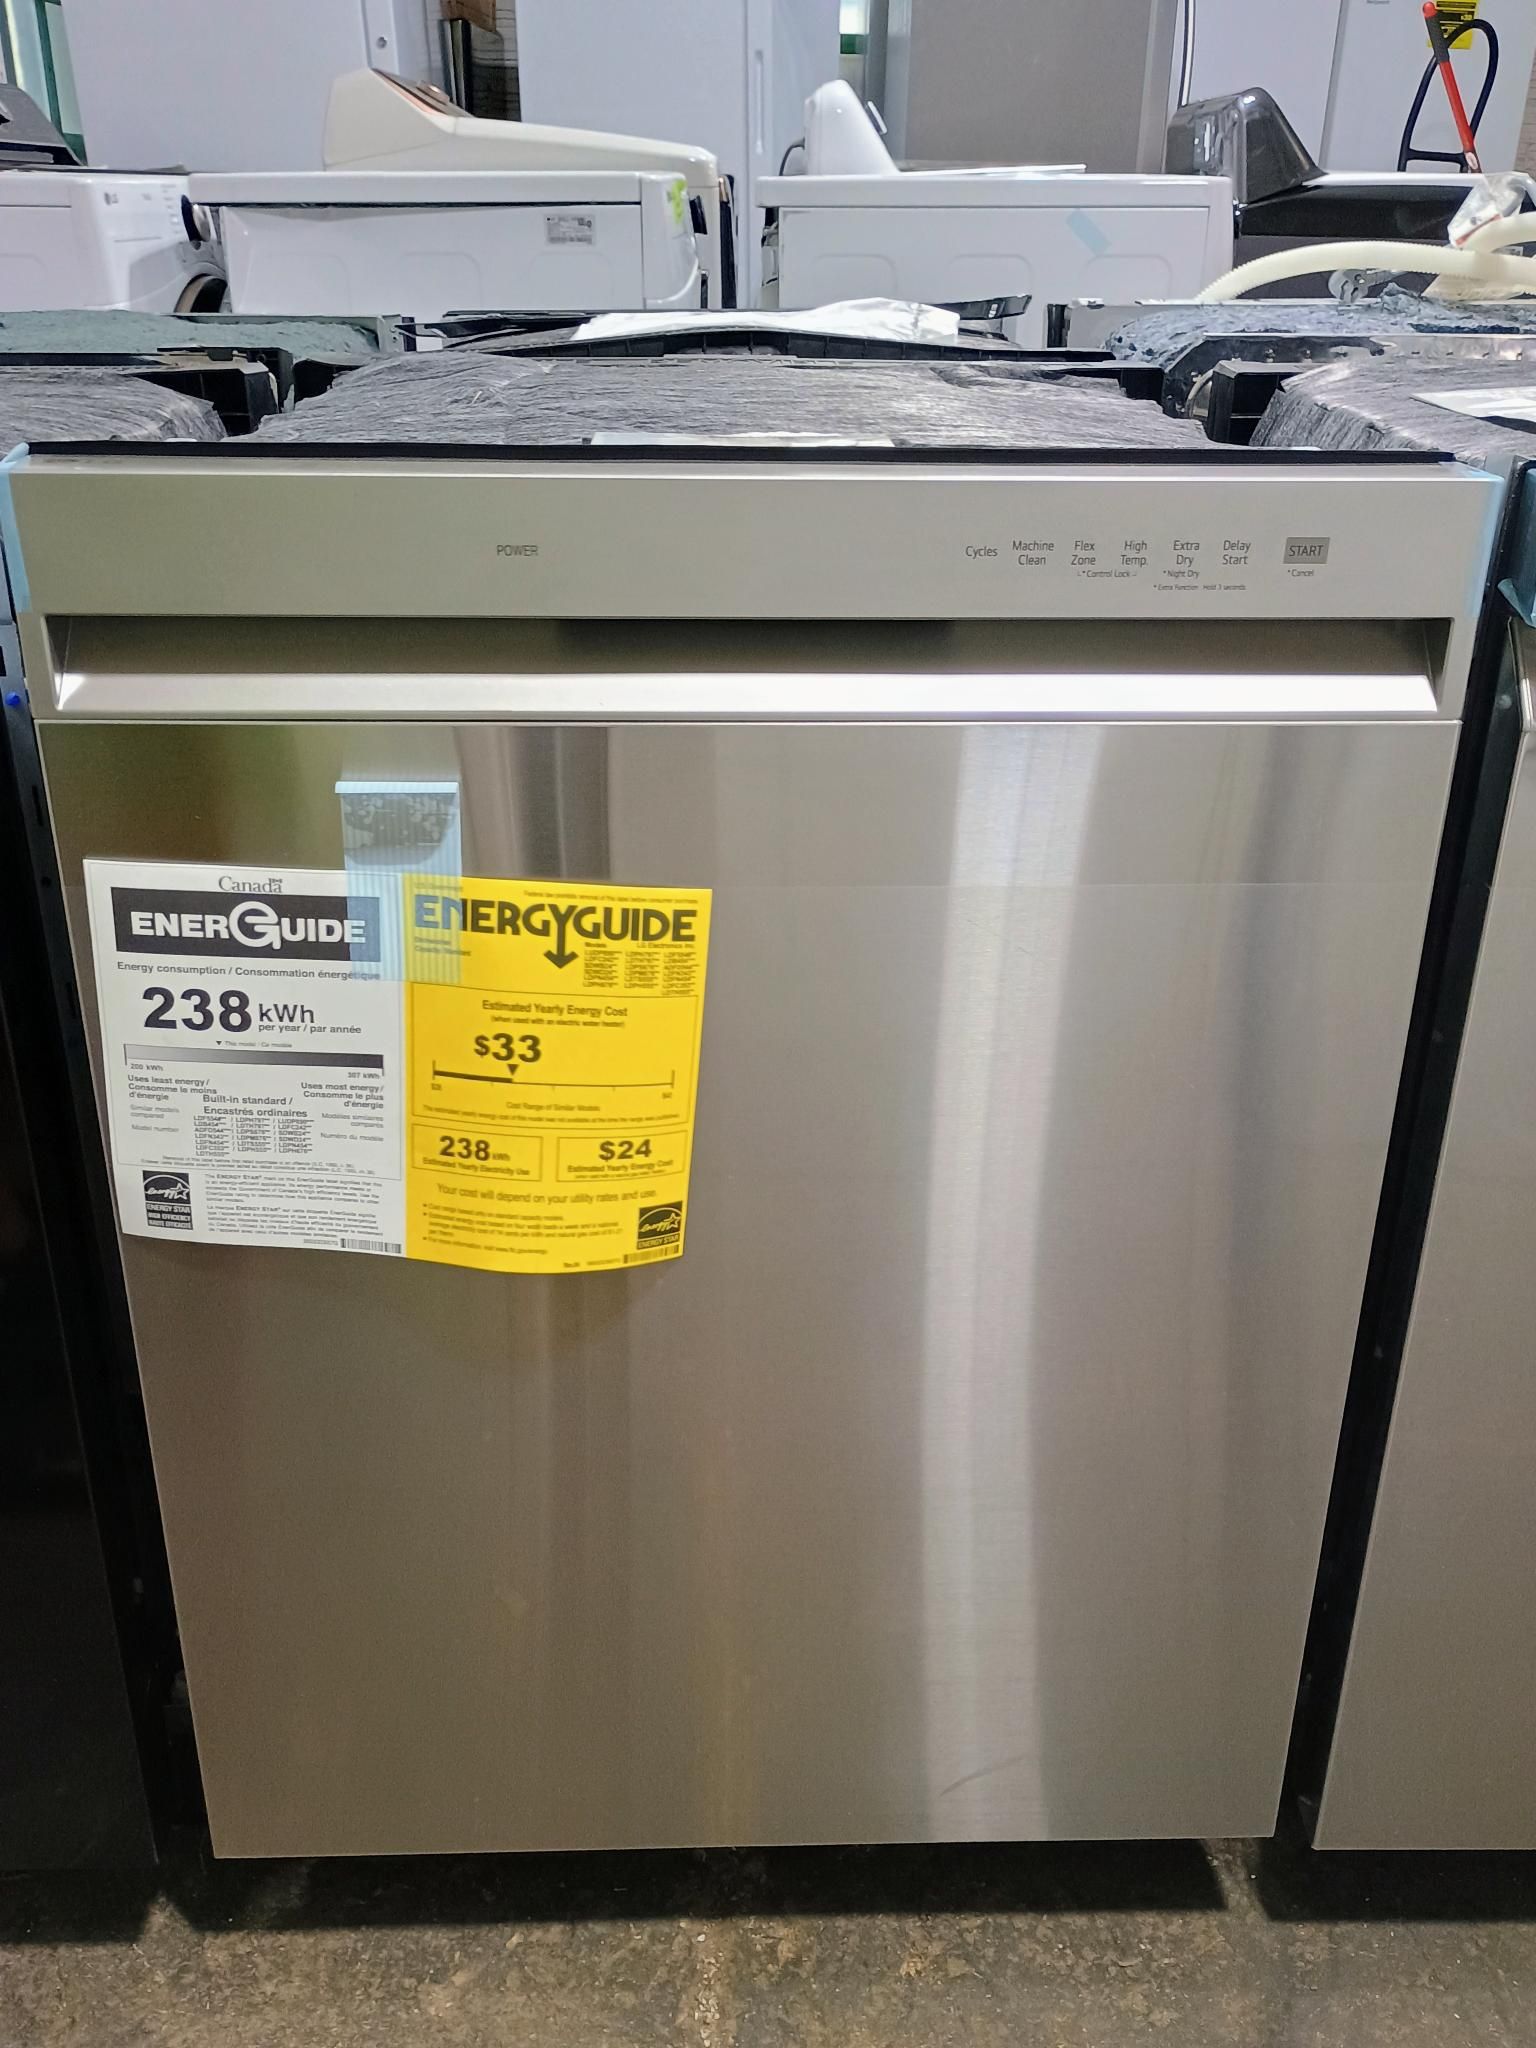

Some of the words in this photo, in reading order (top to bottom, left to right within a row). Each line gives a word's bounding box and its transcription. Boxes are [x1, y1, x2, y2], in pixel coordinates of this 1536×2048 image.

[496, 544, 538, 556] POWER
[965, 545, 998, 559] Cycles
[1012, 540, 1055, 552] Machine
[1074, 540, 1095, 552] Flex
[1124, 540, 1147, 554] High
[1173, 540, 1200, 552] Extra
[1223, 540, 1251, 554] Delay
[1288, 545, 1325, 557] START
[1018, 554, 1046, 566] Clean
[1071, 554, 1096, 566] Zone
[1176, 554, 1194, 567] Dry
[1222, 554, 1249, 566] Start
[1114, 570, 1130, 578] Lock
[1187, 570, 1200, 579] Dry
[219, 876, 283, 893] Canada
[131, 900, 367, 950] ENERGUIDE
[415, 894, 698, 945] ENERGYGUIDE
[117, 961, 153, 975] Energy
[156, 965, 226, 978] consumption
[235, 967, 315, 980] Consommation
[142, 986, 252, 1033] 238
[258, 1003, 315, 1024] kWh
[482, 1000, 532, 1013] Estimated
[534, 1003, 564, 1016] Yearly
[566, 1004, 602, 1018] Energy
[604, 1006, 628, 1018] Cost
[258, 1023, 277, 1033] per
[278, 1024, 301, 1034] year
[310, 1025, 327, 1034] par
[329, 1023, 362, 1034] année
[473, 1033, 542, 1063] $33
[128, 1074, 149, 1083] Uses
[151, 1076, 173, 1084] least
[128, 1083, 178, 1092] Consomme
[190, 1086, 217, 1094] moins
[301, 1081, 323, 1090] Uses
[325, 1083, 347, 1091] most
[202, 1094, 239, 1104] Built-in
[242, 1096, 287, 1105] standard
[303, 1090, 353, 1100] Consomme
[365, 1093, 384, 1102] plus
[203, 1105, 254, 1116] Encastrés
[256, 1107, 308, 1118] ordinaires
[439, 1135, 491, 1161] 238
[598, 1138, 652, 1162] $24
[437, 1183, 457, 1196] Your
[459, 1187, 478, 1198] cost
[479, 1188, 495, 1200] will
[496, 1191, 530, 1204] depend
[532, 1194, 546, 1203] on
[546, 1195, 568, 1206] your
[569, 1193, 594, 1205] utility
[595, 1192, 619, 1202] rates
[620, 1190, 638, 1201] and
